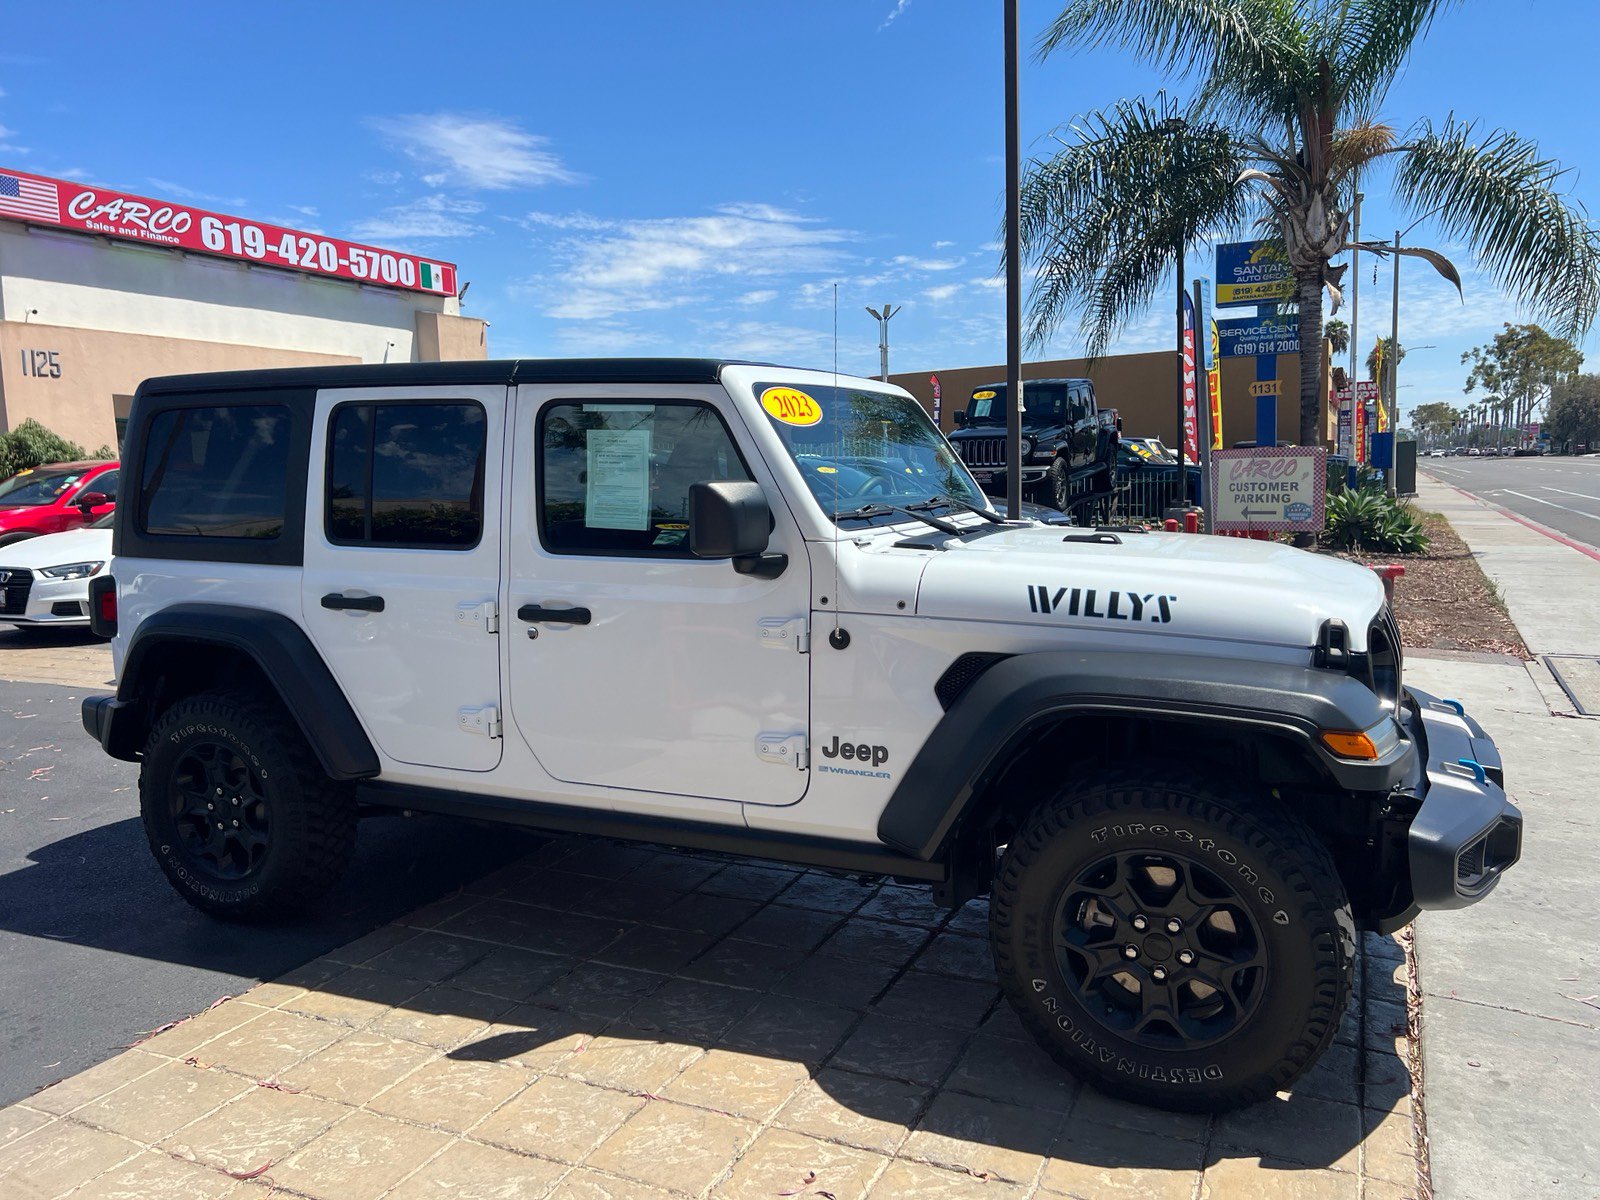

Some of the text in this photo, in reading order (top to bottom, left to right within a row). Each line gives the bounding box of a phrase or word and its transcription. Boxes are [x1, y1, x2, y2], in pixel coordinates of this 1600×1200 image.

[68, 191, 192, 234] CARCO
[85, 220, 180, 244] Sales and Finance
[200, 216, 416, 287] 619-420-5700
[1233, 263, 1292, 276] SANTAN
[1236, 274, 1261, 283] AUTO
[1232, 286, 1253, 296] (619)
[1219, 324, 1298, 338] SERVICE CENT
[1233, 340, 1300, 355] (619) 614 2000
[21, 349, 61, 379] 1125
[1252, 383, 1277, 394] 1131
[773, 394, 813, 418] 2023
[1229, 458, 1298, 481] CARCO
[1229, 482, 1299, 492] CUSTOMER
[1234, 494, 1291, 503] PARKING
[1027, 584, 1177, 623] WILLYS
[821, 735, 889, 767] Jeep
[1091, 823, 1275, 904] Firestone
[1042, 997, 1223, 1084] DESTINATION
